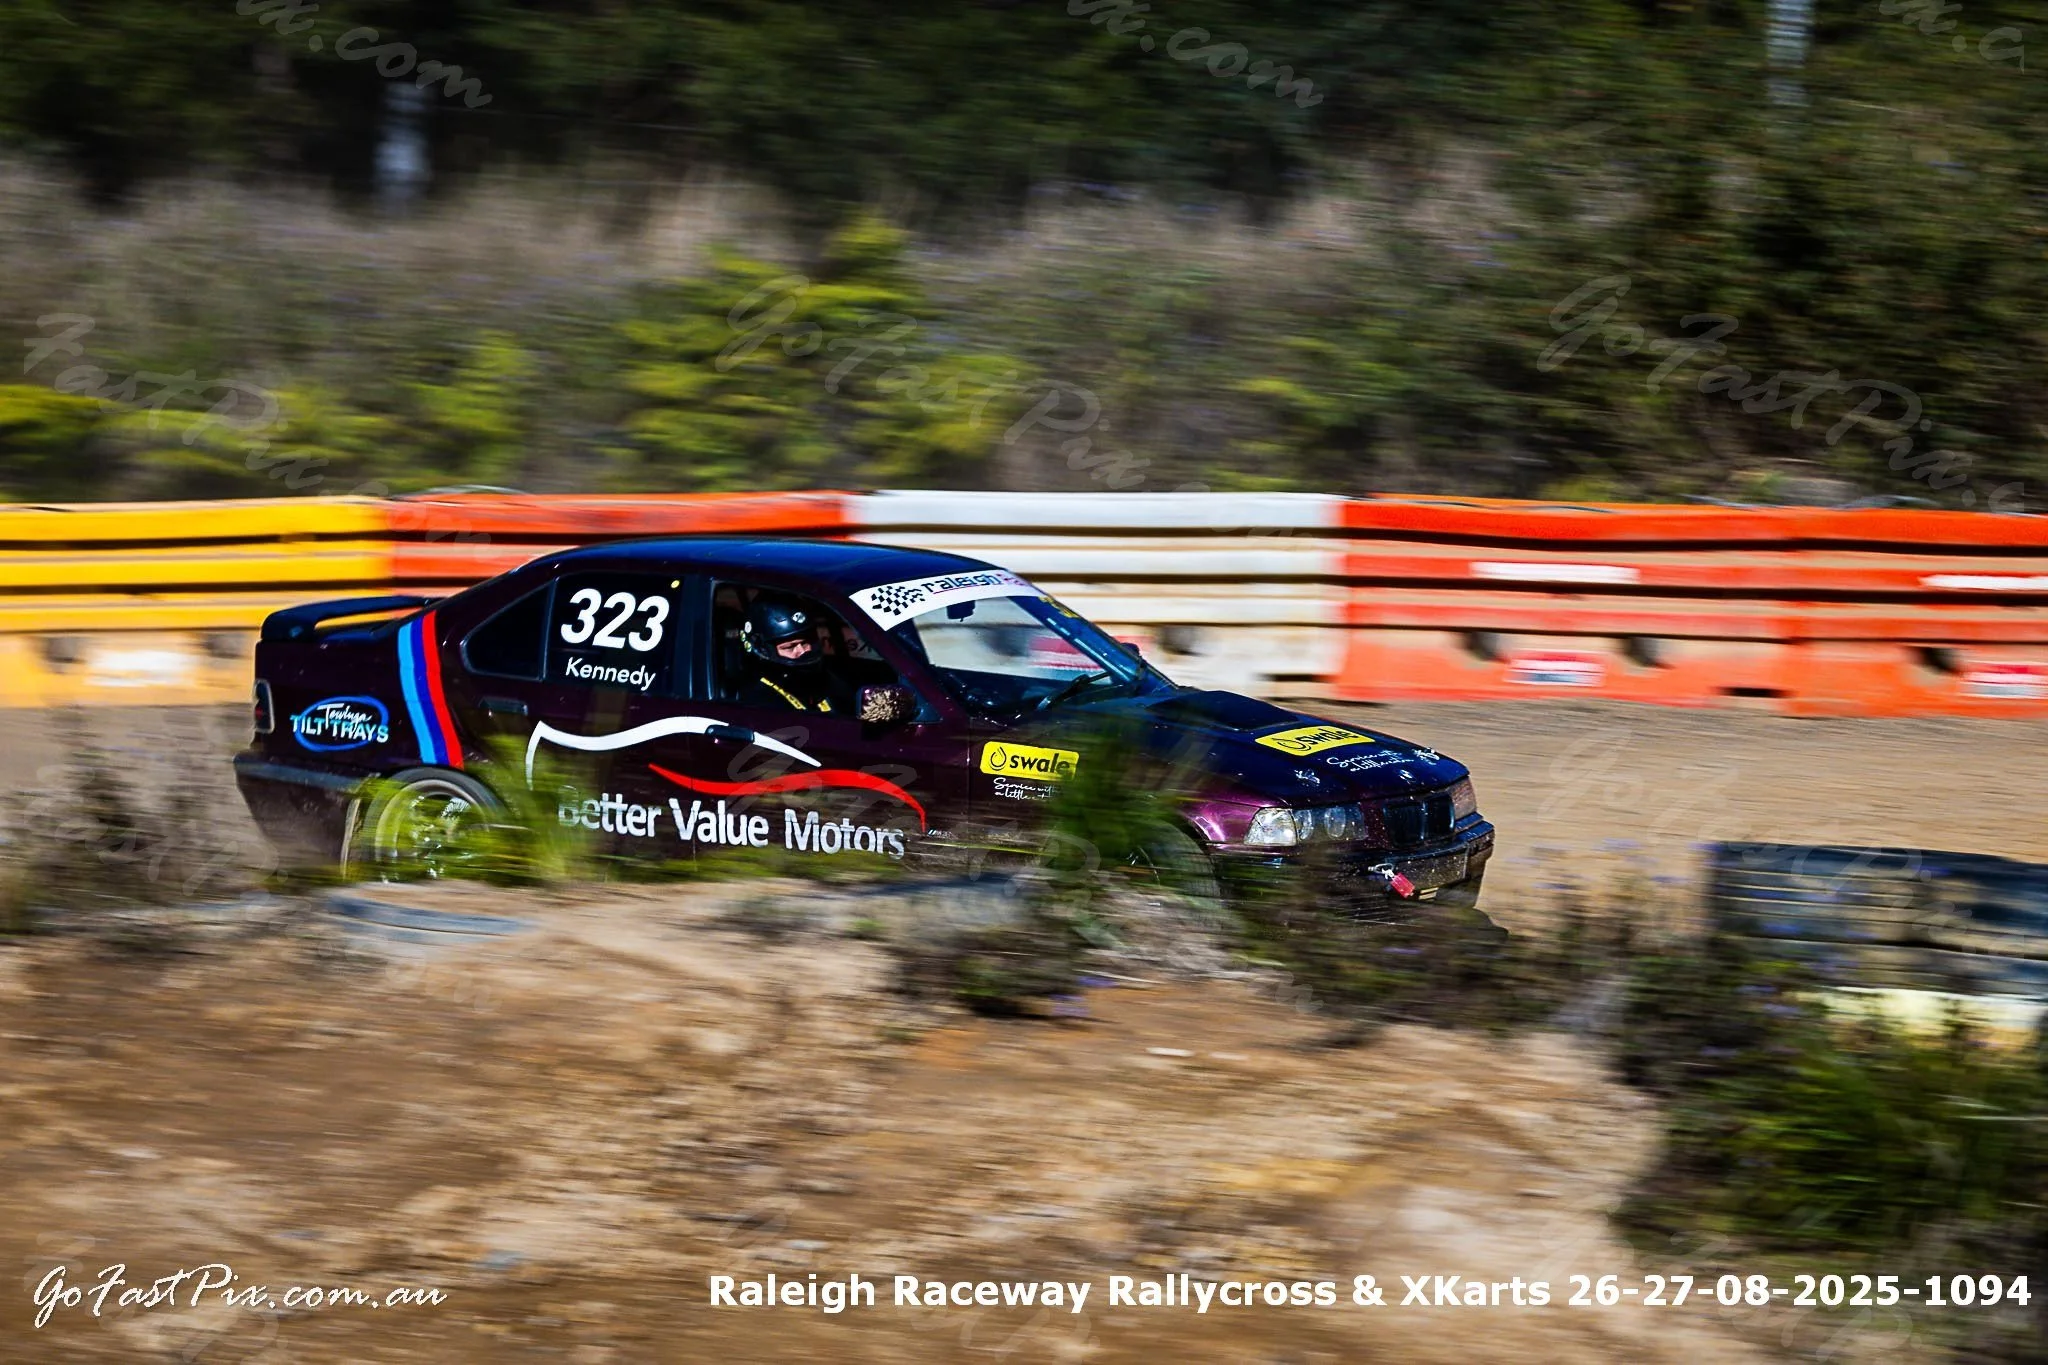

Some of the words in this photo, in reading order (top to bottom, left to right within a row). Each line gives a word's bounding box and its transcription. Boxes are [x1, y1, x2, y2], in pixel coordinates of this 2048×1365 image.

[921, 573, 1001, 593] raleigh
[559, 587, 671, 652] 323
[565, 656, 656, 691] Kennedy
[290, 714, 326, 736] TILT
[330, 719, 389, 743] TRAYS
[1009, 752, 1071, 774] swale
[557, 785, 662, 838] Better
[668, 797, 770, 848] Value
[784, 808, 905, 860] Motors
